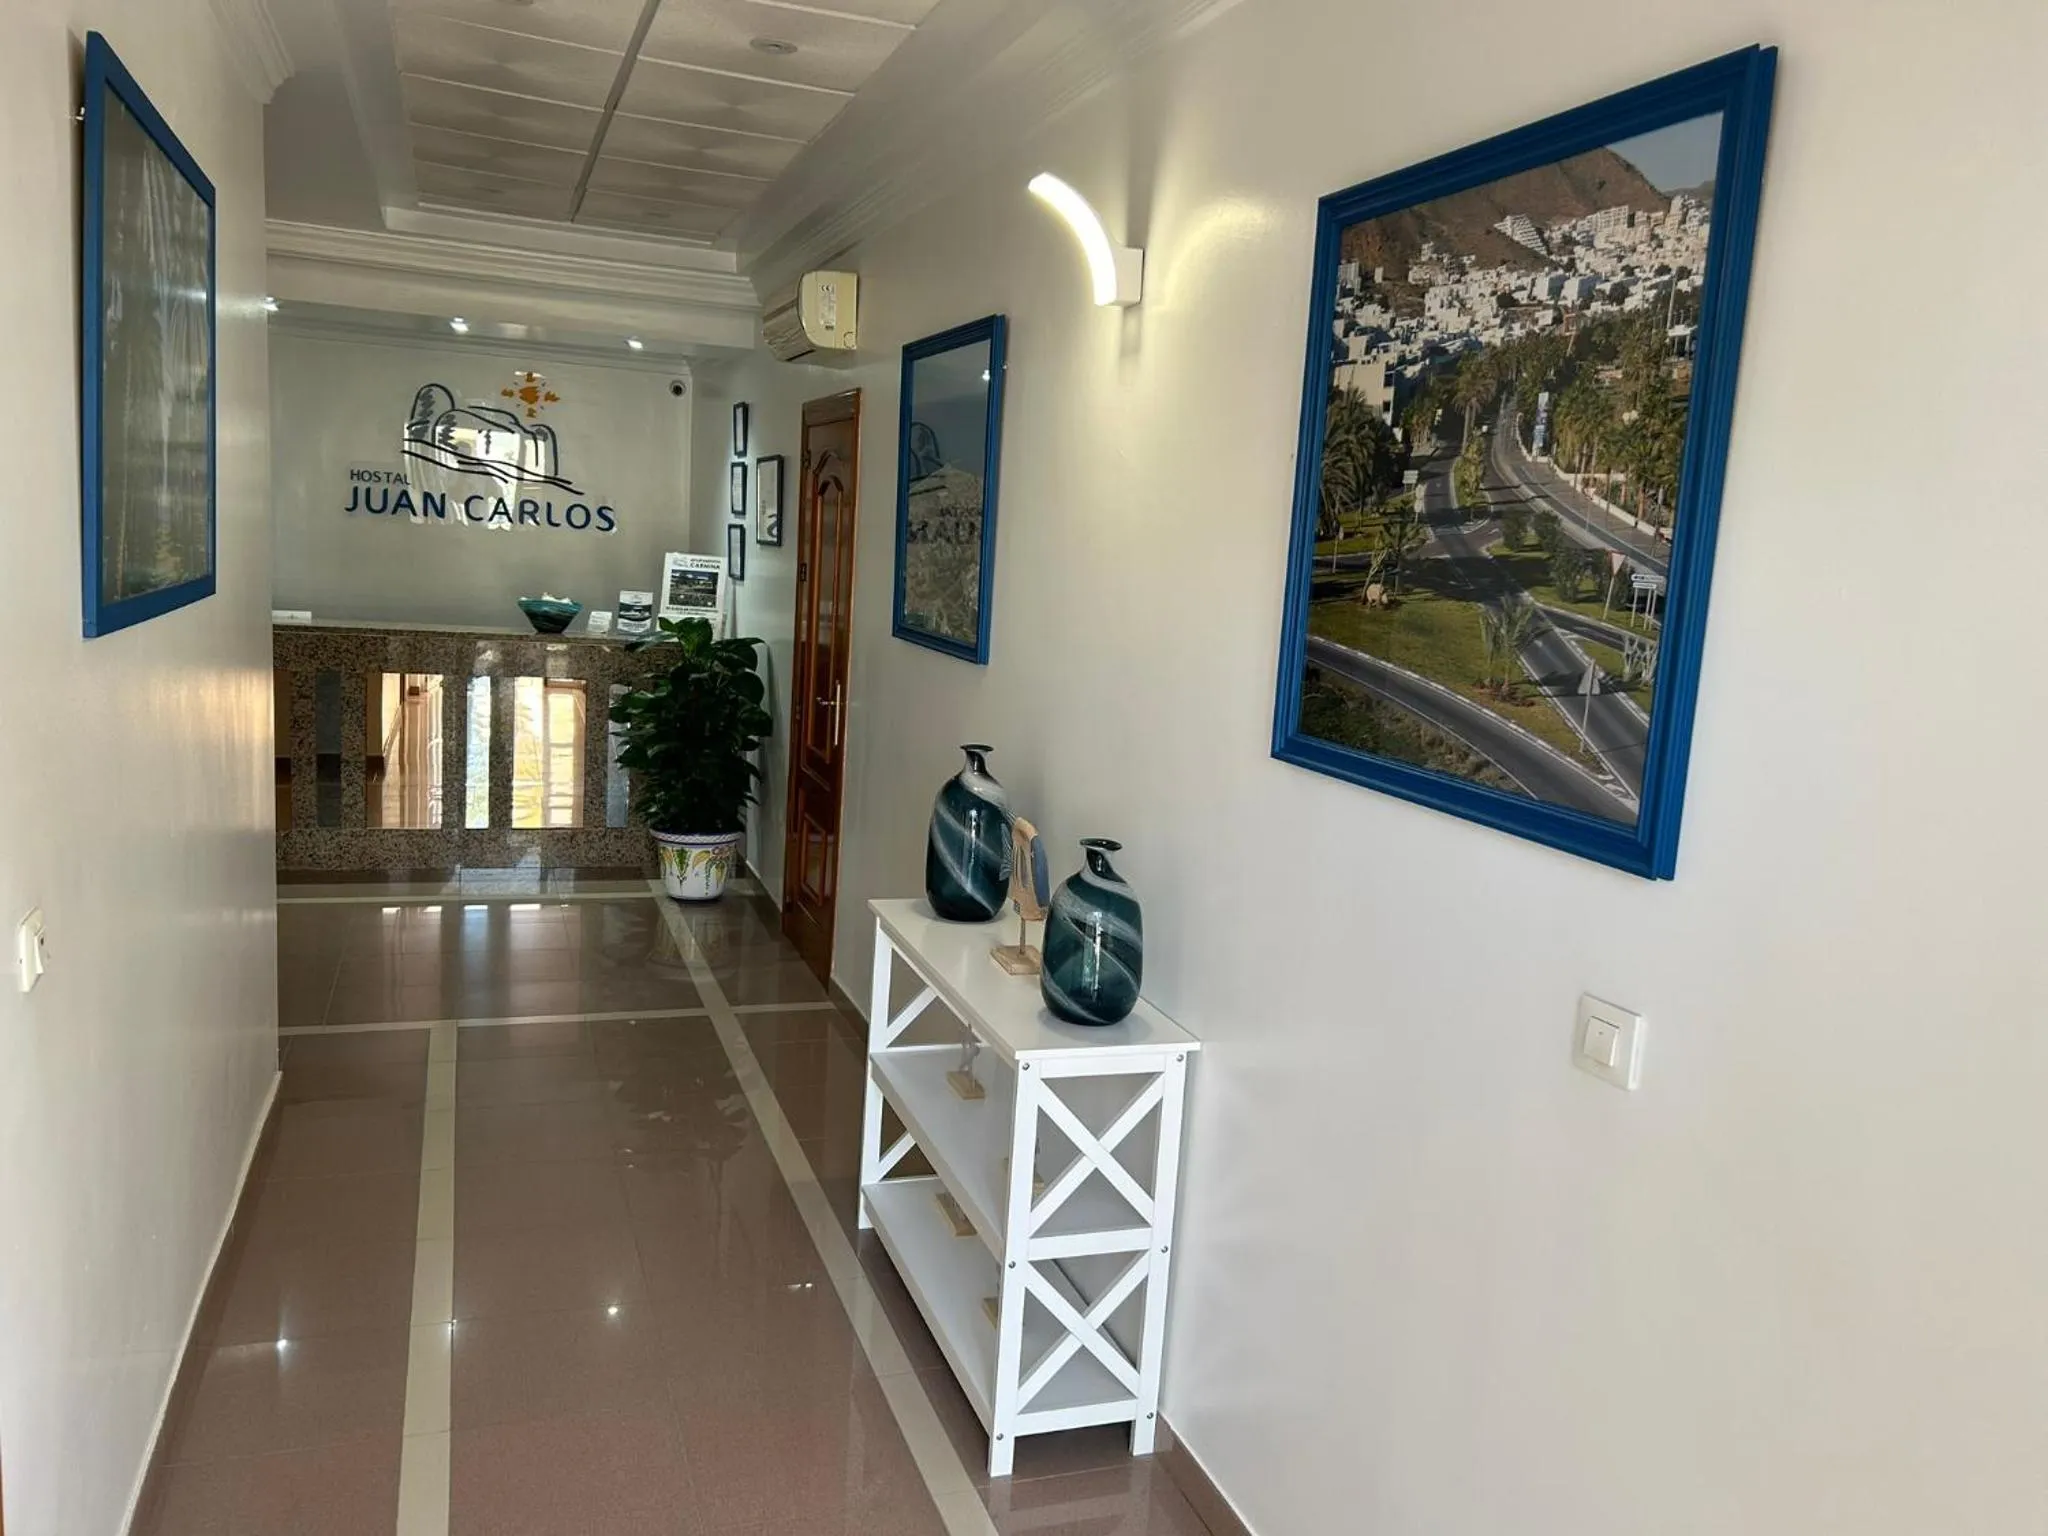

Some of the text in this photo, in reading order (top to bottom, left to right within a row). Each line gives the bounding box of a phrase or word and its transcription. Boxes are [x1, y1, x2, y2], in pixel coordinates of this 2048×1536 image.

[350, 469, 411, 486] HOSTAL
[345, 486, 615, 532] JUAN CARLOS
